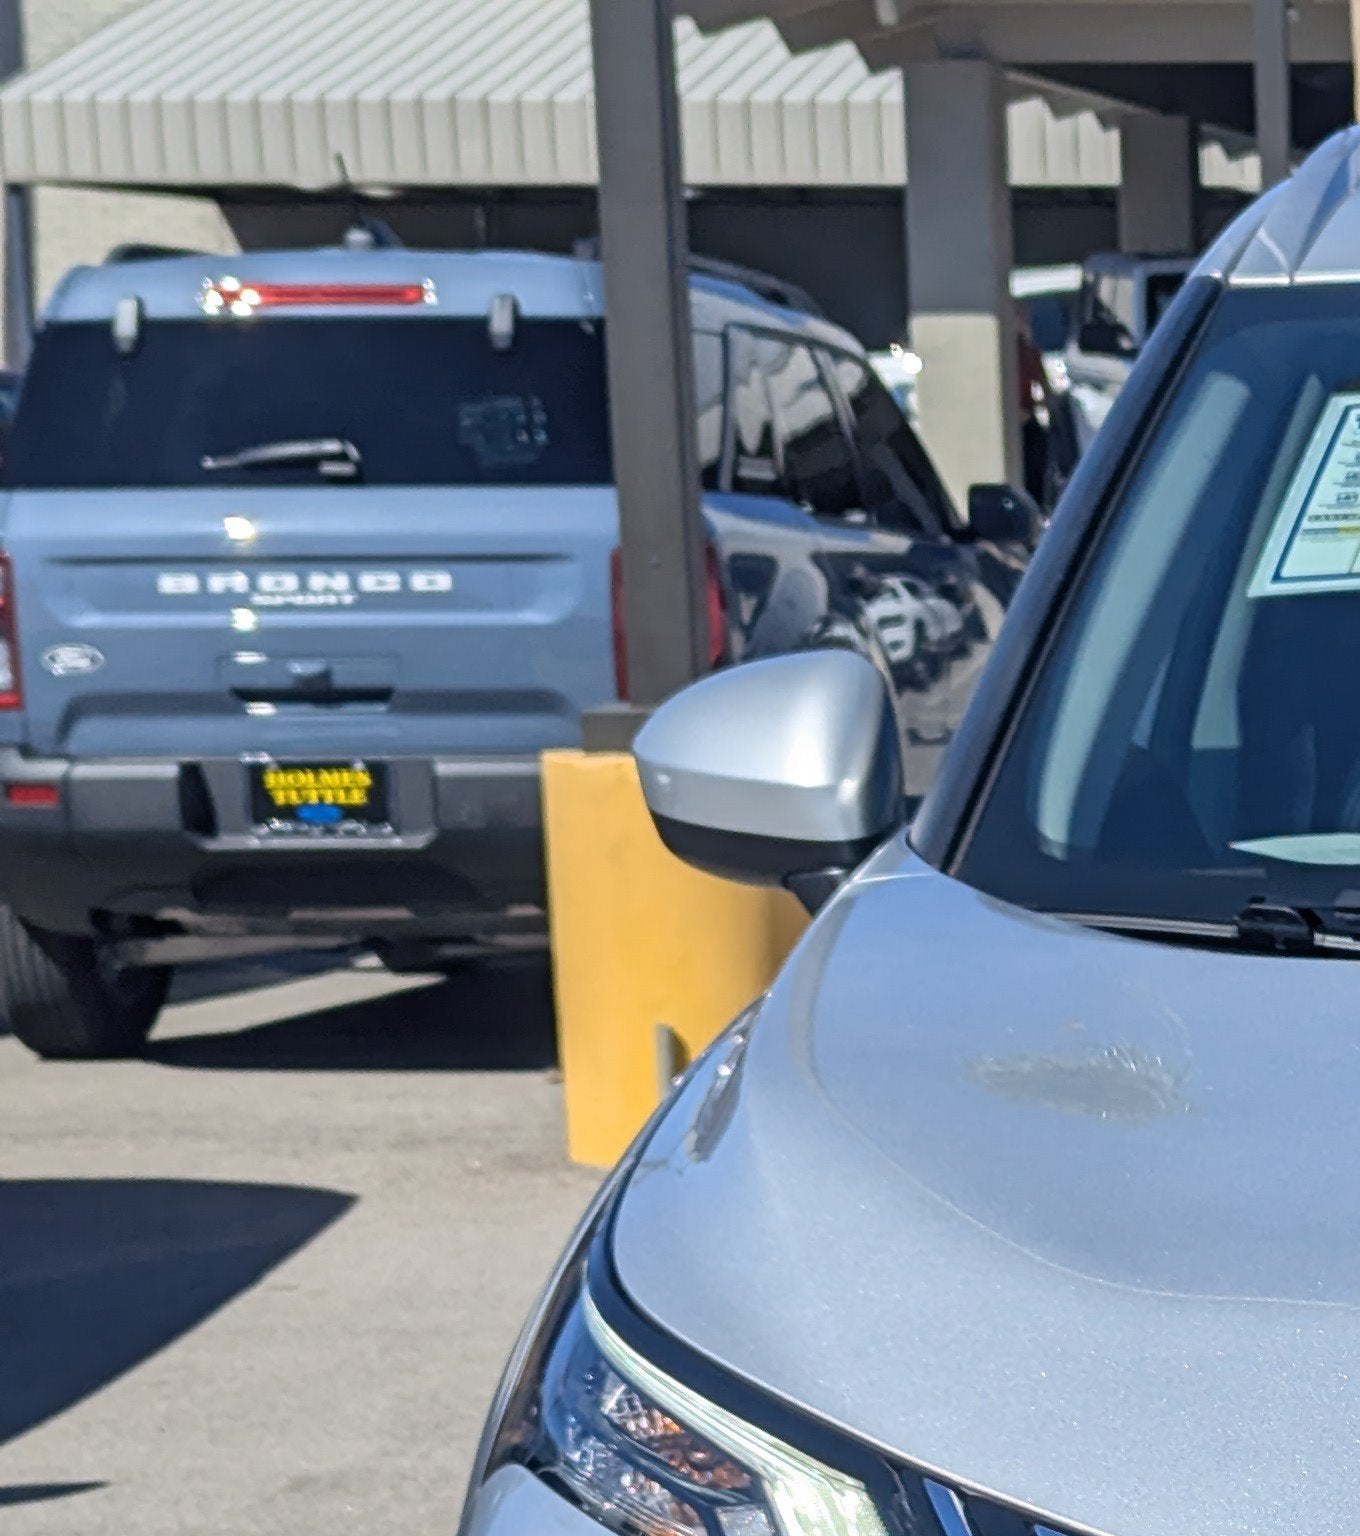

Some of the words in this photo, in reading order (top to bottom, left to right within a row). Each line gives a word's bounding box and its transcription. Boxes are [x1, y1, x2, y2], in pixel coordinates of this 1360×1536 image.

[157, 571, 452, 595] BRONCO
[264, 769, 372, 788] HOLMES
[268, 789, 368, 806] TUTTLE
